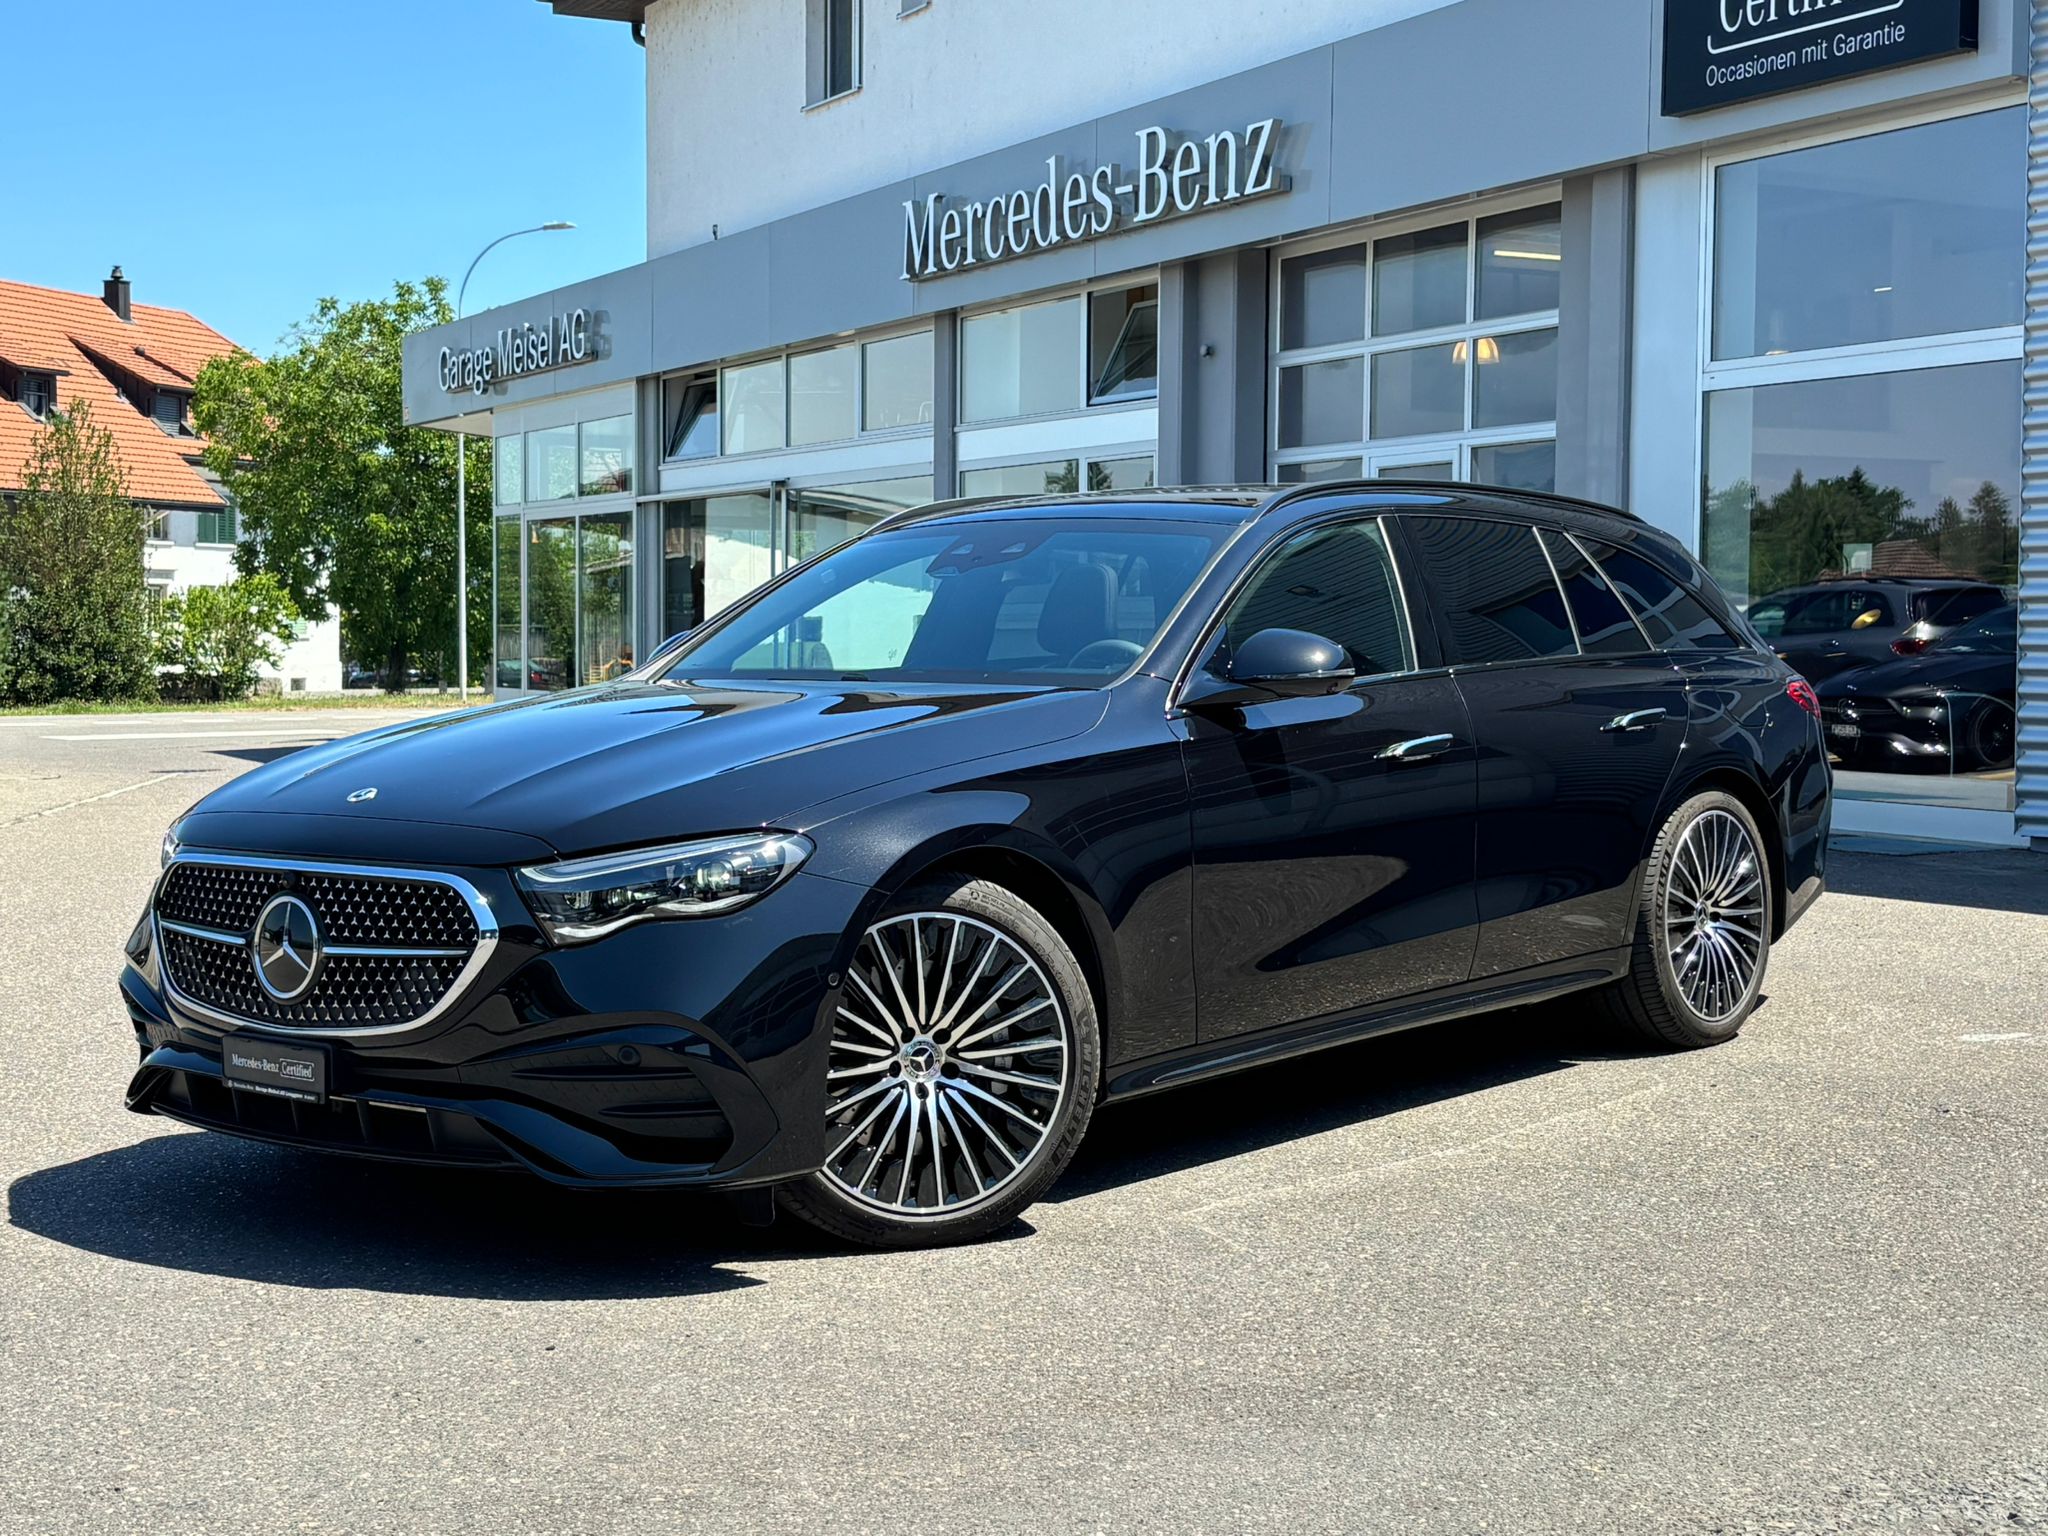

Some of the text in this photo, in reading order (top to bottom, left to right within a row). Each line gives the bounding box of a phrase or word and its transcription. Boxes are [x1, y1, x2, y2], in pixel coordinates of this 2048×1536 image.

[1705, 21, 1906, 88] Occasionen mit Garantie
[899, 118, 1276, 280] Mercedes-Benz
[438, 308, 585, 396] Garage Meisel AG
[231, 1053, 312, 1078] Mercedes-Benz Certified
[1051, 1043, 1092, 1165] MICHELIN
